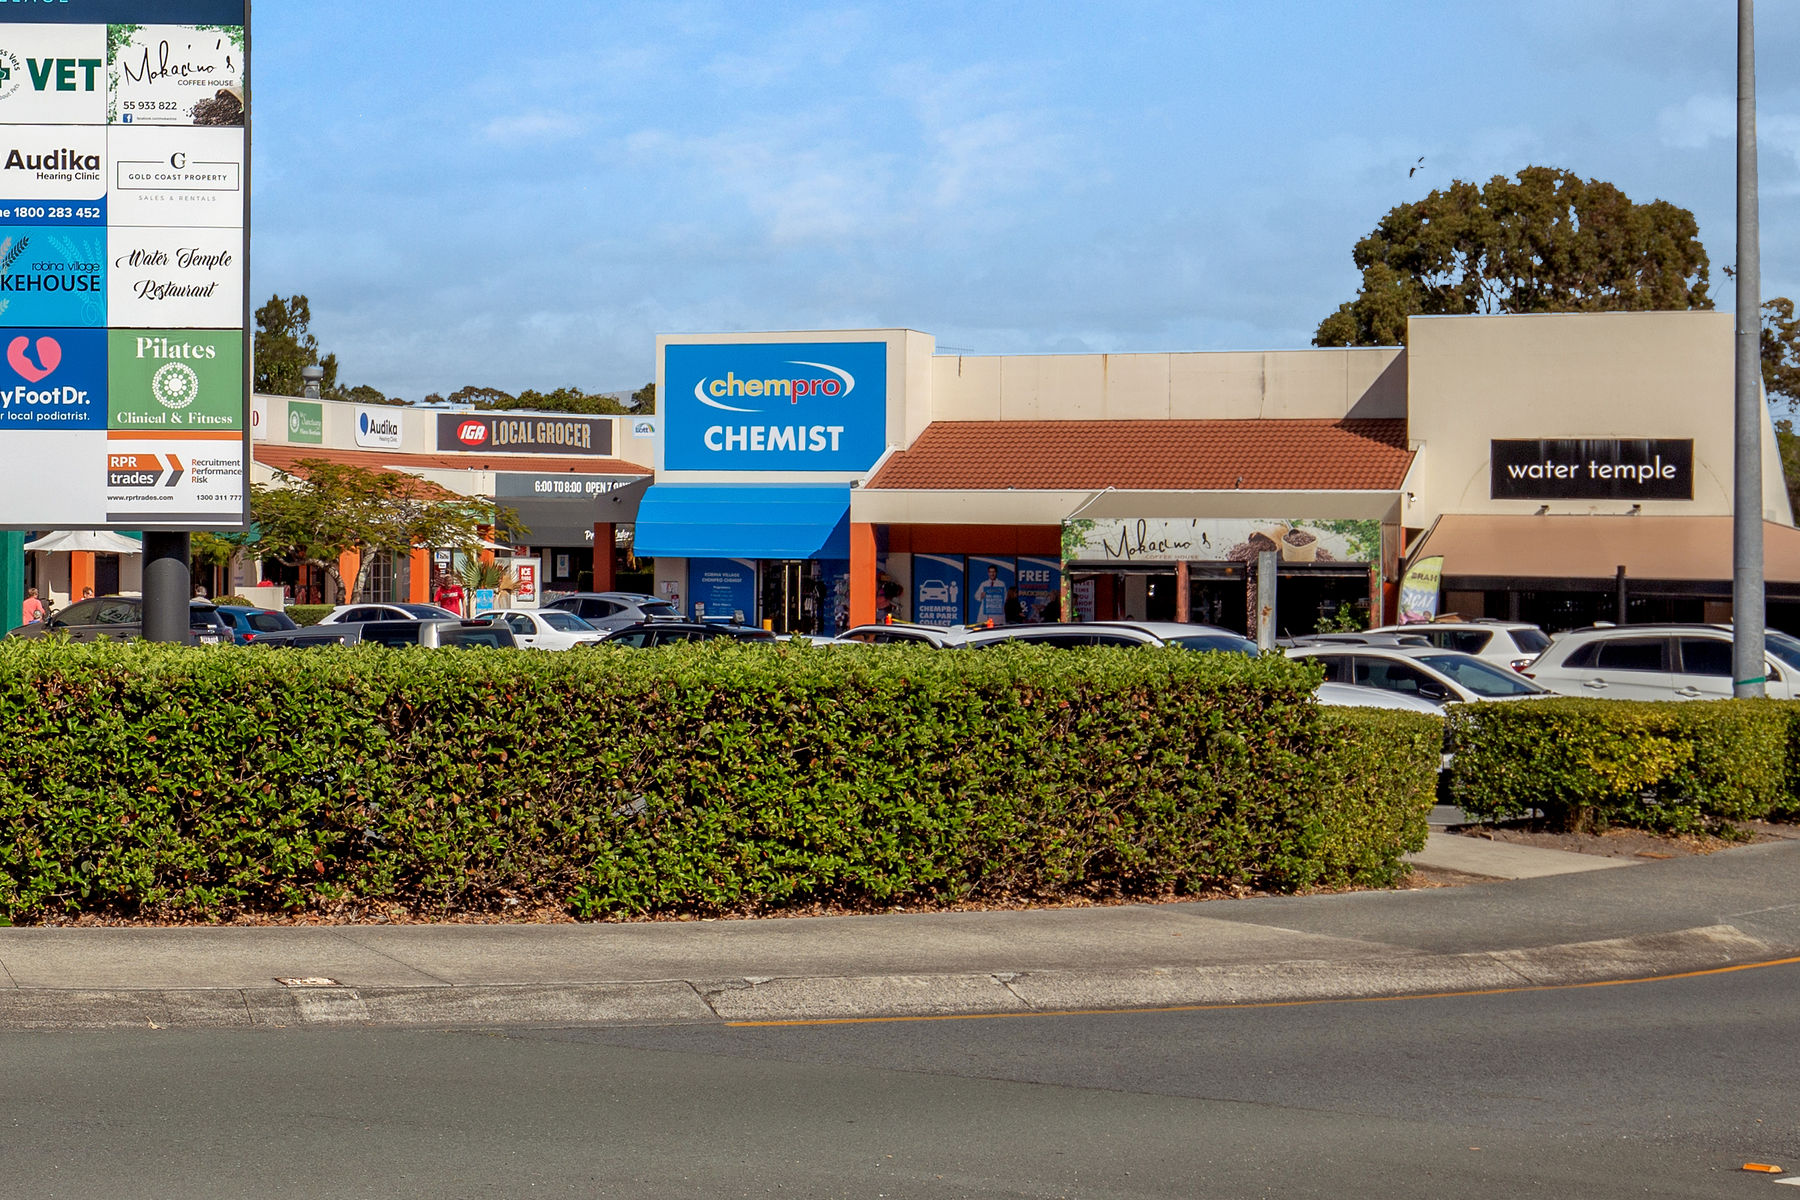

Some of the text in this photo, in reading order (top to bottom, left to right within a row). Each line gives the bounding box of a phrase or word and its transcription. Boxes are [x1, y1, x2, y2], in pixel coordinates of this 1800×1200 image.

[8, 52, 21, 72] Vets
[26, 58, 102, 91] VET
[123, 101, 177, 110] 55 933 822
[4, 148, 100, 171] Audika
[170, 152, 186, 170] G
[36, 172, 100, 181] Hearing Clinic
[14, 207, 44, 218] 1800
[48, 207, 73, 218] 283
[76, 207, 100, 218] 452
[115, 247, 232, 271] Water Temple
[31, 261, 100, 274] robina village
[133, 279, 219, 301] Restaurant
[136, 337, 216, 359] Pilates
[708, 371, 842, 405] chempro
[7, 411, 33, 420] local
[36, 411, 90, 423] podiatrist.
[116, 411, 233, 424] Clinical & Fitness
[369, 418, 398, 435] Audika
[460, 420, 591, 449] IGA LOCAL GROCER
[704, 425, 845, 453] CHEMIST
[110, 456, 138, 468] RPR
[191, 459, 241, 467] Recruitment
[191, 467, 242, 476] Performance
[1507, 455, 1677, 484] water temple
[110, 472, 154, 484] trades
[534, 480, 552, 493] 6:00
[553, 481, 565, 493] TO
[564, 481, 582, 493] 8:00
[585, 481, 607, 494] OPEN
[606, 482, 613, 494] 7
[520, 567, 532, 576] ICE
[1018, 569, 1050, 582] FREE
[919, 605, 958, 613] CHEMPRO
